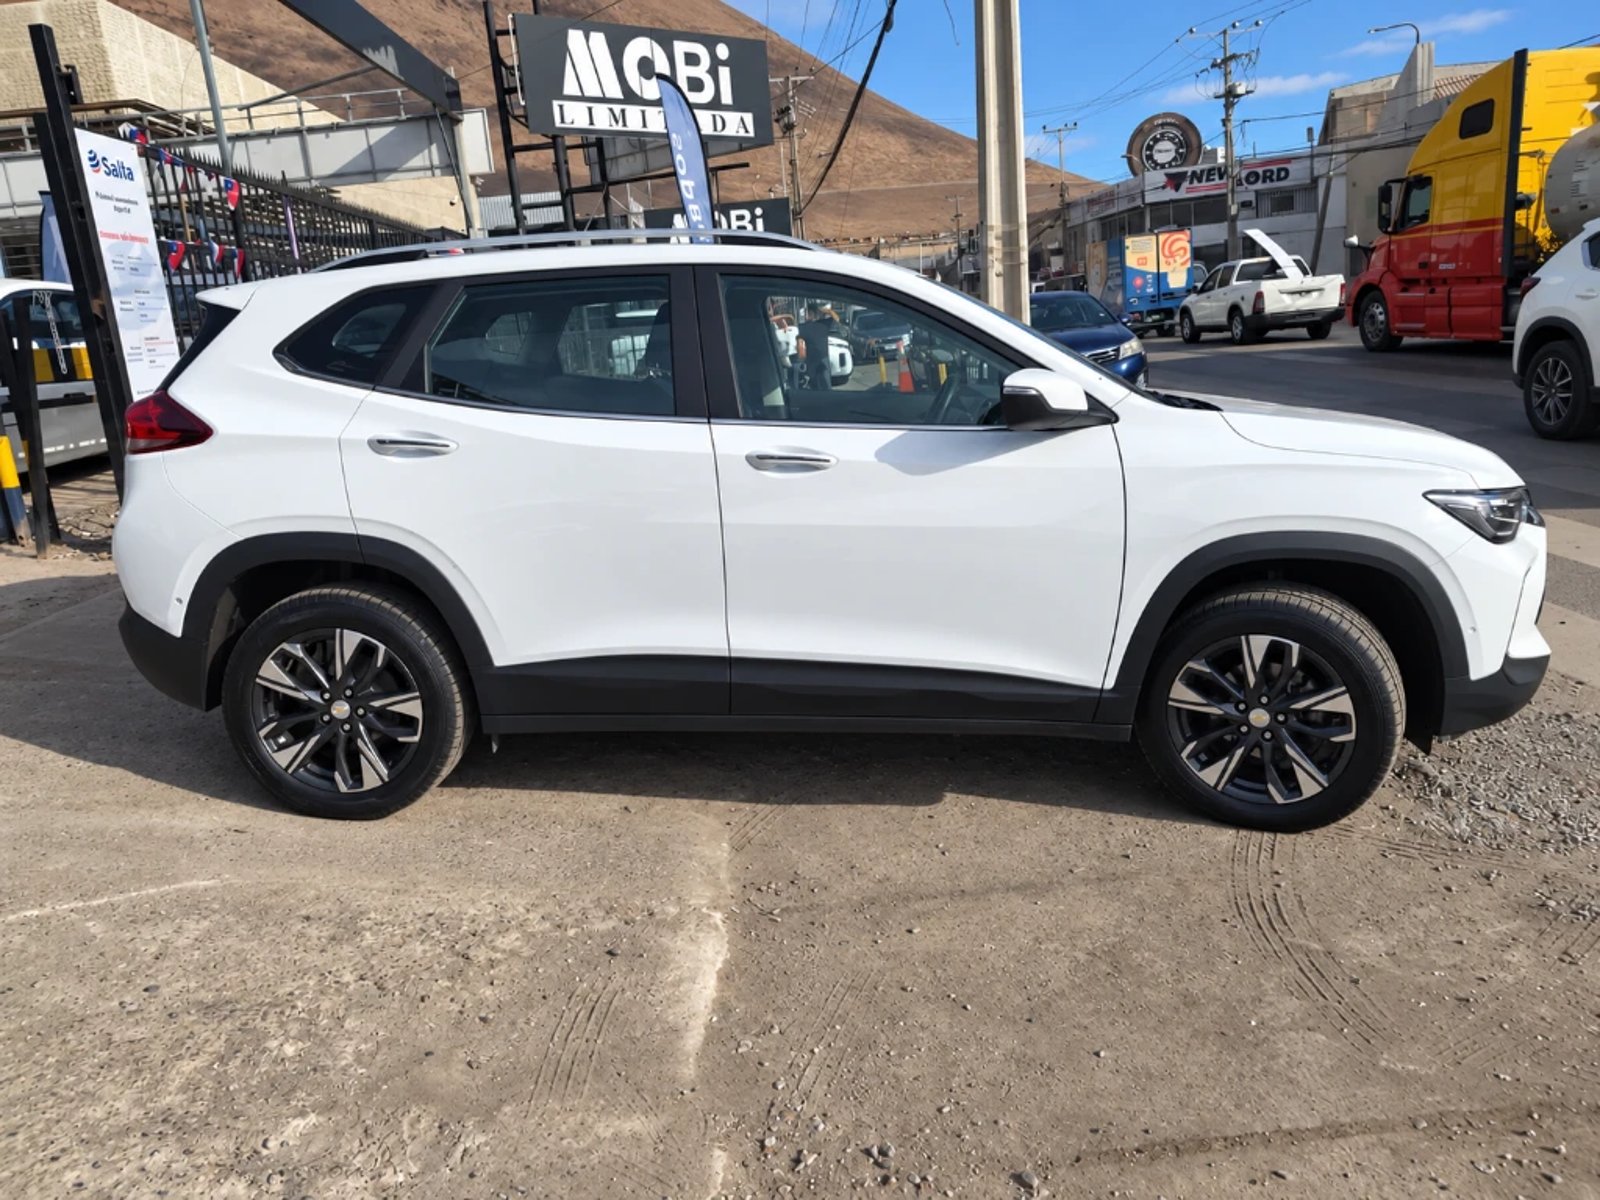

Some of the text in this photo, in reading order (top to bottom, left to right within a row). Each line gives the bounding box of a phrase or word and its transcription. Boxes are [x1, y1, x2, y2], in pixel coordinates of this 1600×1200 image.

[562, 28, 734, 105] MOBi
[557, 103, 751, 135] LIMIDA
[101, 156, 135, 182] Salta
